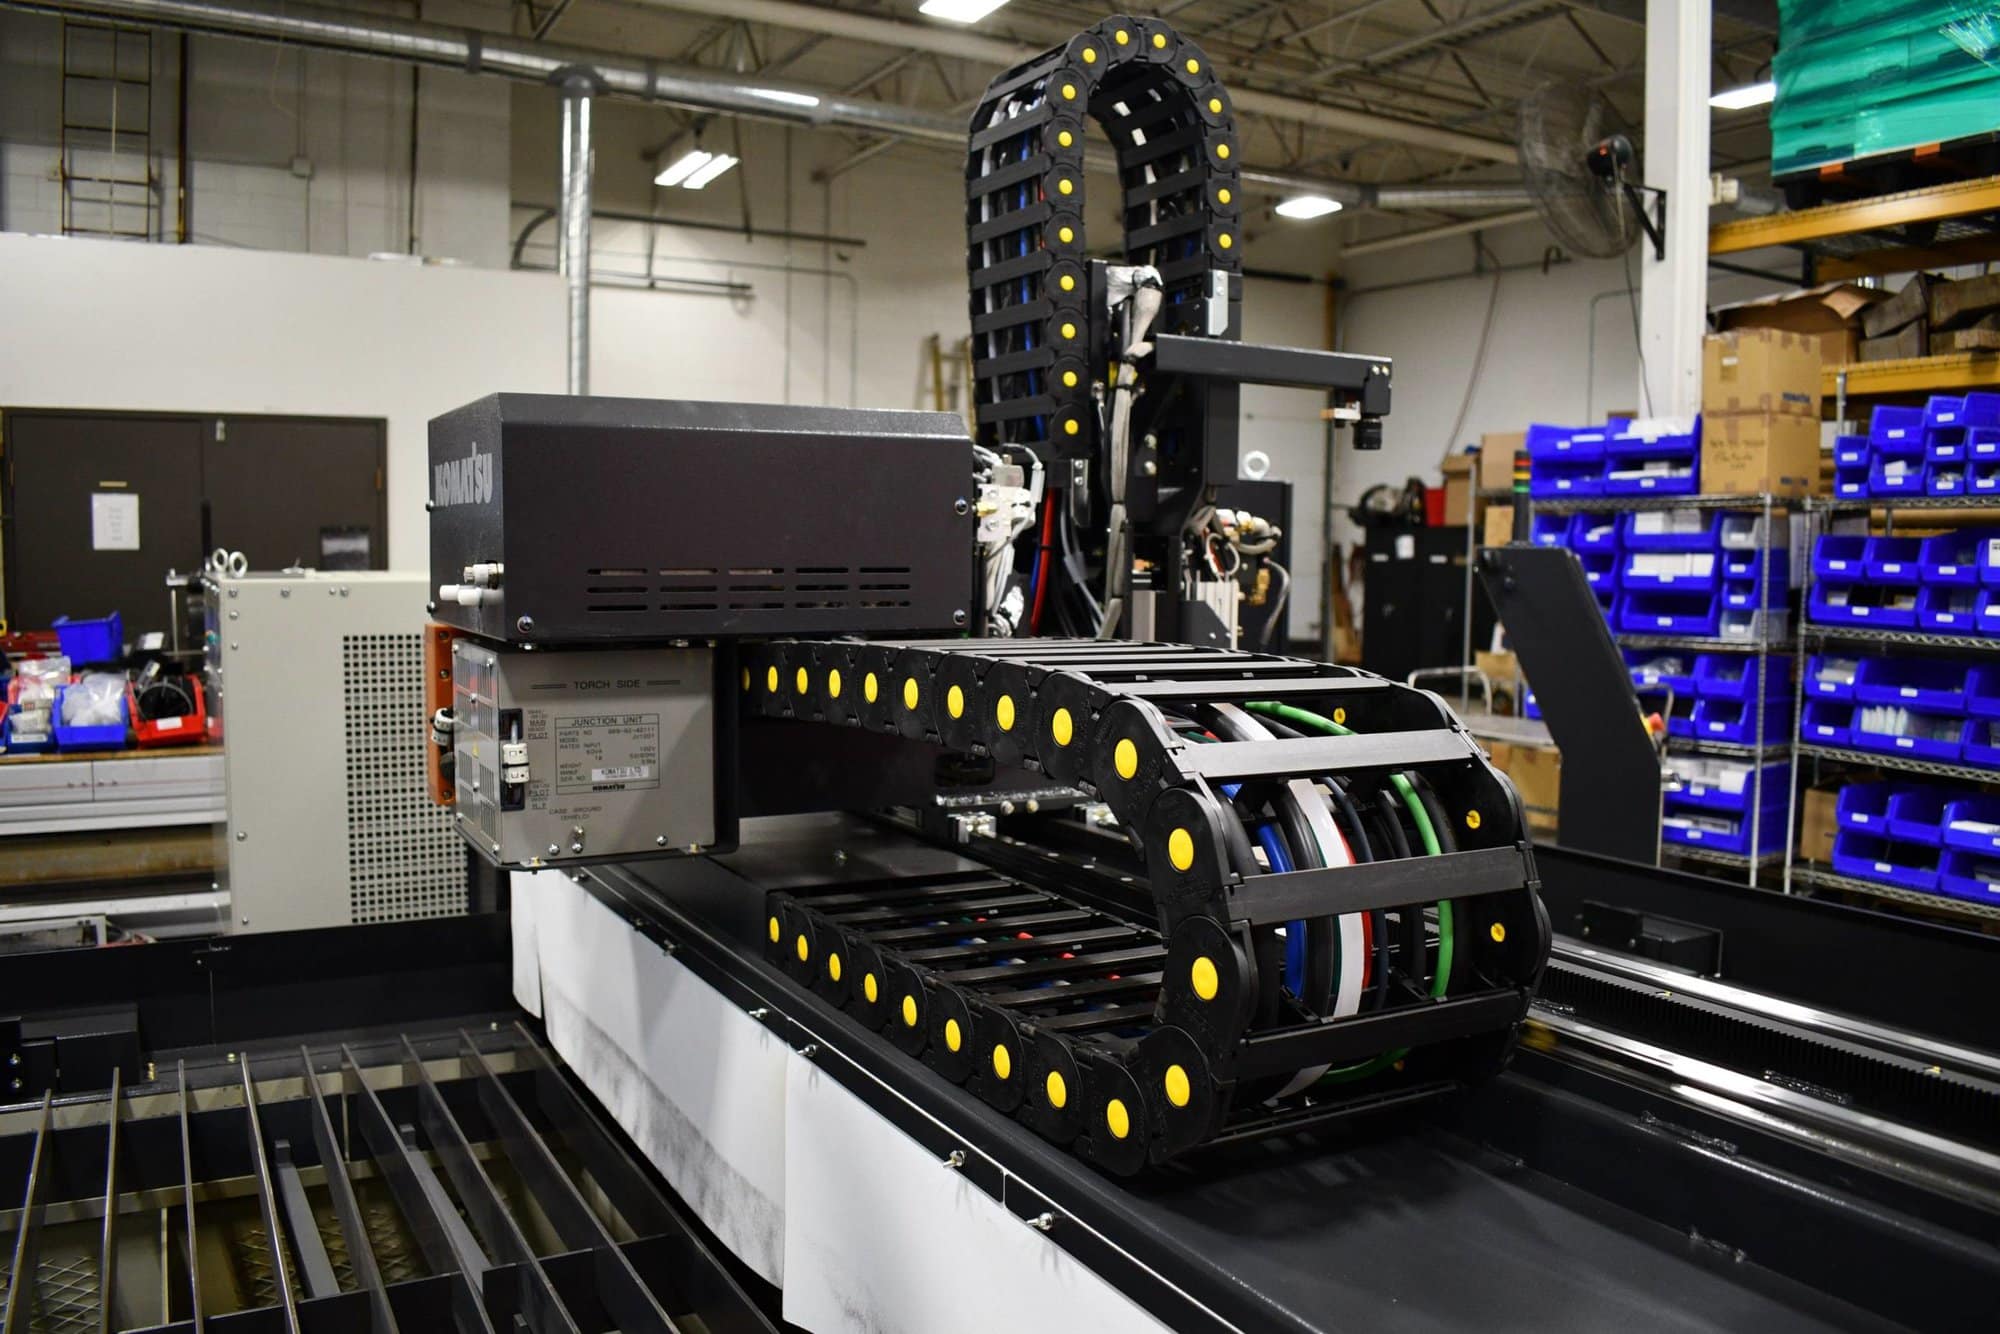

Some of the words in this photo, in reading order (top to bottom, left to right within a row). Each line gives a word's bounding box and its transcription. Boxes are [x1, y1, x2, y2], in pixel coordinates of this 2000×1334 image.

[435, 441, 493, 506] KOMATSU
[574, 680, 610, 690] TORCH
[616, 679, 641, 689] SIDE
[572, 717, 617, 727] JUNCTION
[623, 715, 643, 724] UNIT
